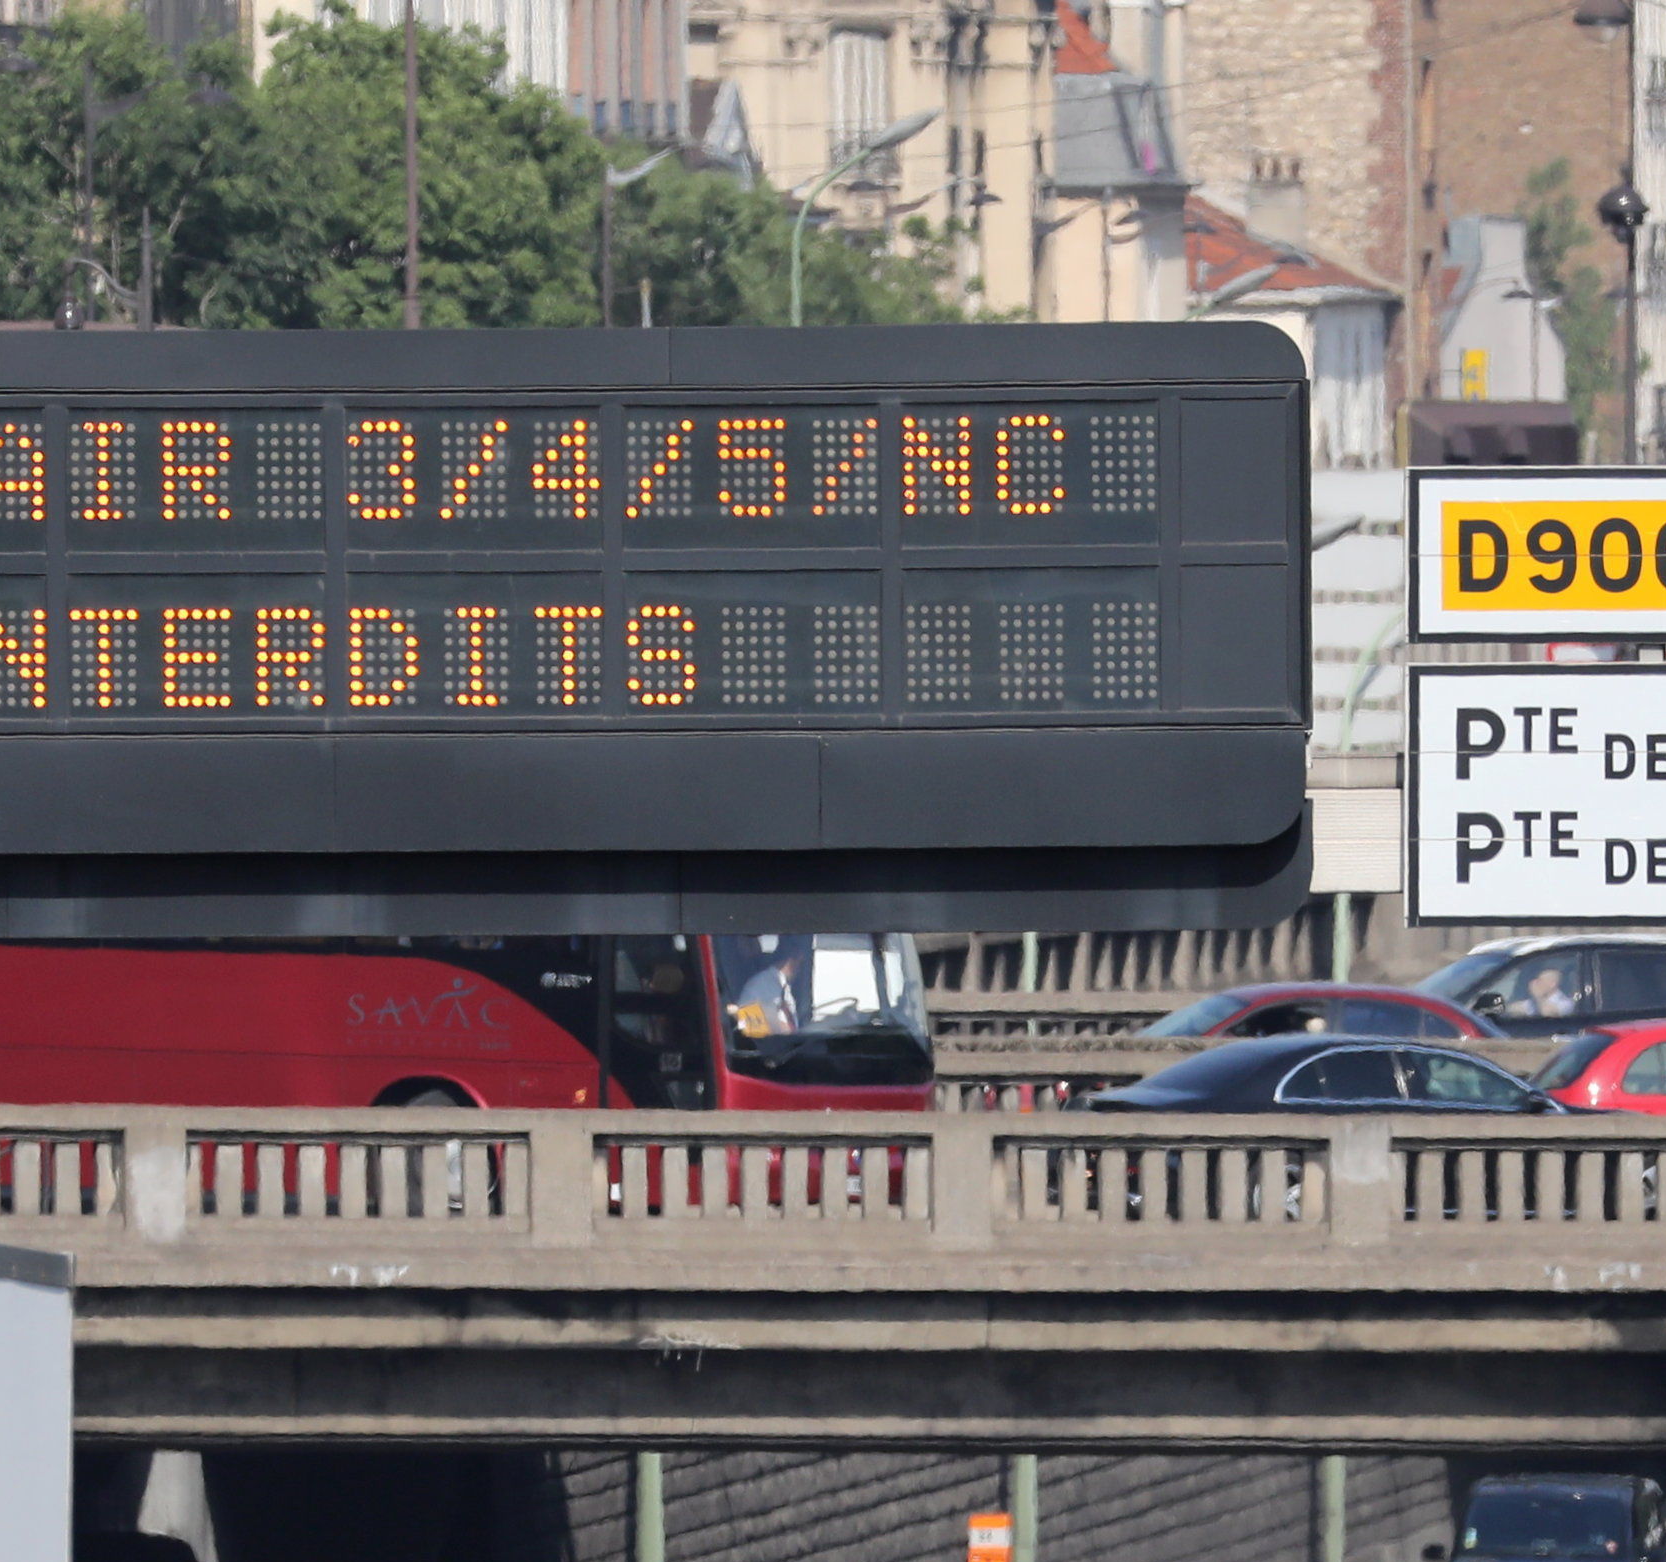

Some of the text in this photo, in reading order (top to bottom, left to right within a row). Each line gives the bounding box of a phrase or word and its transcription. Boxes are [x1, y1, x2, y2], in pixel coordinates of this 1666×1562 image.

[345, 414, 1066, 520] 3/4/5/NC
[1456, 707, 1579, 780] PTE
[1456, 811, 1579, 883] PTE
[346, 990, 510, 1029] SAVAC
